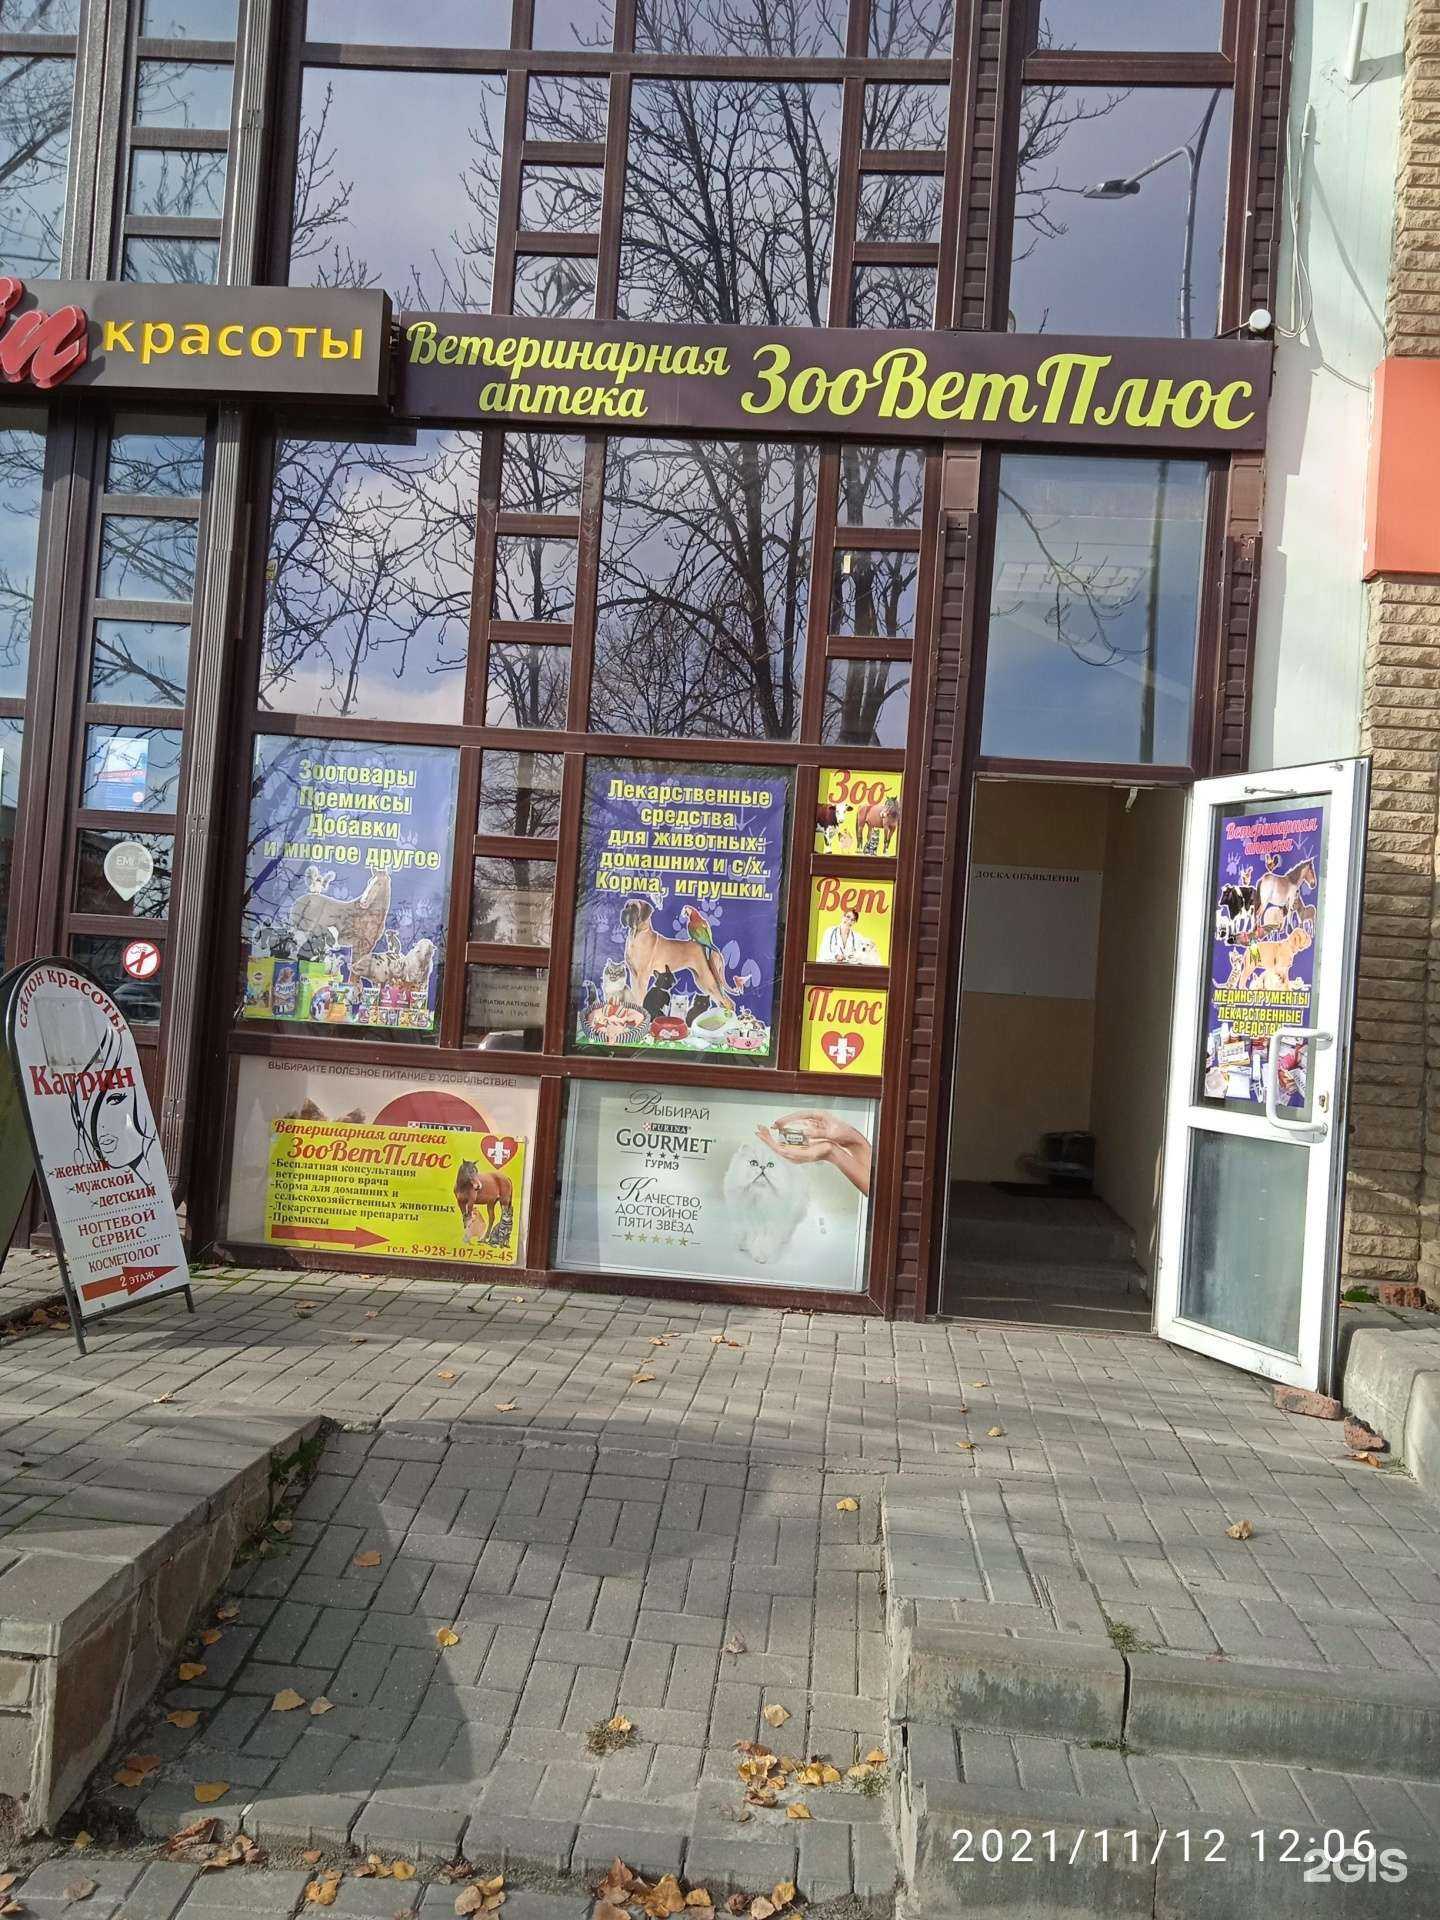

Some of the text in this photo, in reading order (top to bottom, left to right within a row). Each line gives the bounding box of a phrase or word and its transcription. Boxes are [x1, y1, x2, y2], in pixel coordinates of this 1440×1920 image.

[103, 318, 364, 365] красоты
[406, 321, 731, 384] Ветеринарная
[479, 380, 649, 417] аптека
[739, 343, 1256, 430] ЗооВетПлюс
[298, 758, 417, 788] Зоотовары
[607, 779, 772, 808] Лекарственные
[828, 769, 890, 805] Зоо
[299, 785, 412, 815] Премиксы
[307, 812, 400, 840] Добавки
[640, 807, 736, 830] средства
[607, 829, 766, 854] для животных:
[264, 842, 441, 871] и многое другое
[599, 852, 771, 877] домашних и с/х.
[595, 871, 773, 902] Корма, игрушки.
[975, 871, 1010, 880] ДОСКА
[816, 876, 889, 914] Вет
[20, 969, 127, 1035] салон красоты
[807, 986, 883, 1025] Плюс
[1213, 989, 1310, 1007] МЕДИНСТРУМЕНТЫ
[1217, 1006, 1303, 1025] ЛЕКАРСТВЕННЫЕ
[29, 1064, 136, 1101] Катрин
[328, 1065, 381, 1078] ПОЛЕЗНОЕ
[382, 1069, 427, 1081] ПИТАНИЕ
[625, 1088, 710, 1120] ВЫБИРАЙ
[275, 1120, 448, 1144] Ветеринарная аптека
[616, 1128, 713, 1153] GOURMET
[651, 1123, 688, 1134] PURINA
[287, 1136, 452, 1169] ЗооВетПлюс
[645, 1159, 680, 1171] ГУРМЭ
[54, 1159, 111, 1179] женский
[275, 1171, 389, 1188] ветеринарного врача
[341, 1165, 417, 1178] консультация
[74, 1170, 135, 1195] мужской
[99, 1182, 157, 1207] детский
[311, 1185, 331, 1193] для
[333, 1186, 389, 1198] домашних
[392, 1190, 399, 1198] и
[274, 1192, 456, 1214] сельскохозяйственных животных
[360, 1209, 419, 1222] препараты
[615, 1203, 698, 1221] ДОСТОЙНОЕ
[78, 1207, 157, 1237] НОГТЕВОЙ
[617, 1216, 694, 1234] ПЯТИ ЗВЁЗД
[91, 1226, 148, 1248] СЕРВИС
[88, 1243, 161, 1273] КОСМЕТОЛОГ
[411, 1244, 513, 1261] 8-928-107-95-45
[120, 1270, 156, 1288] 2 ЭТАЖ
